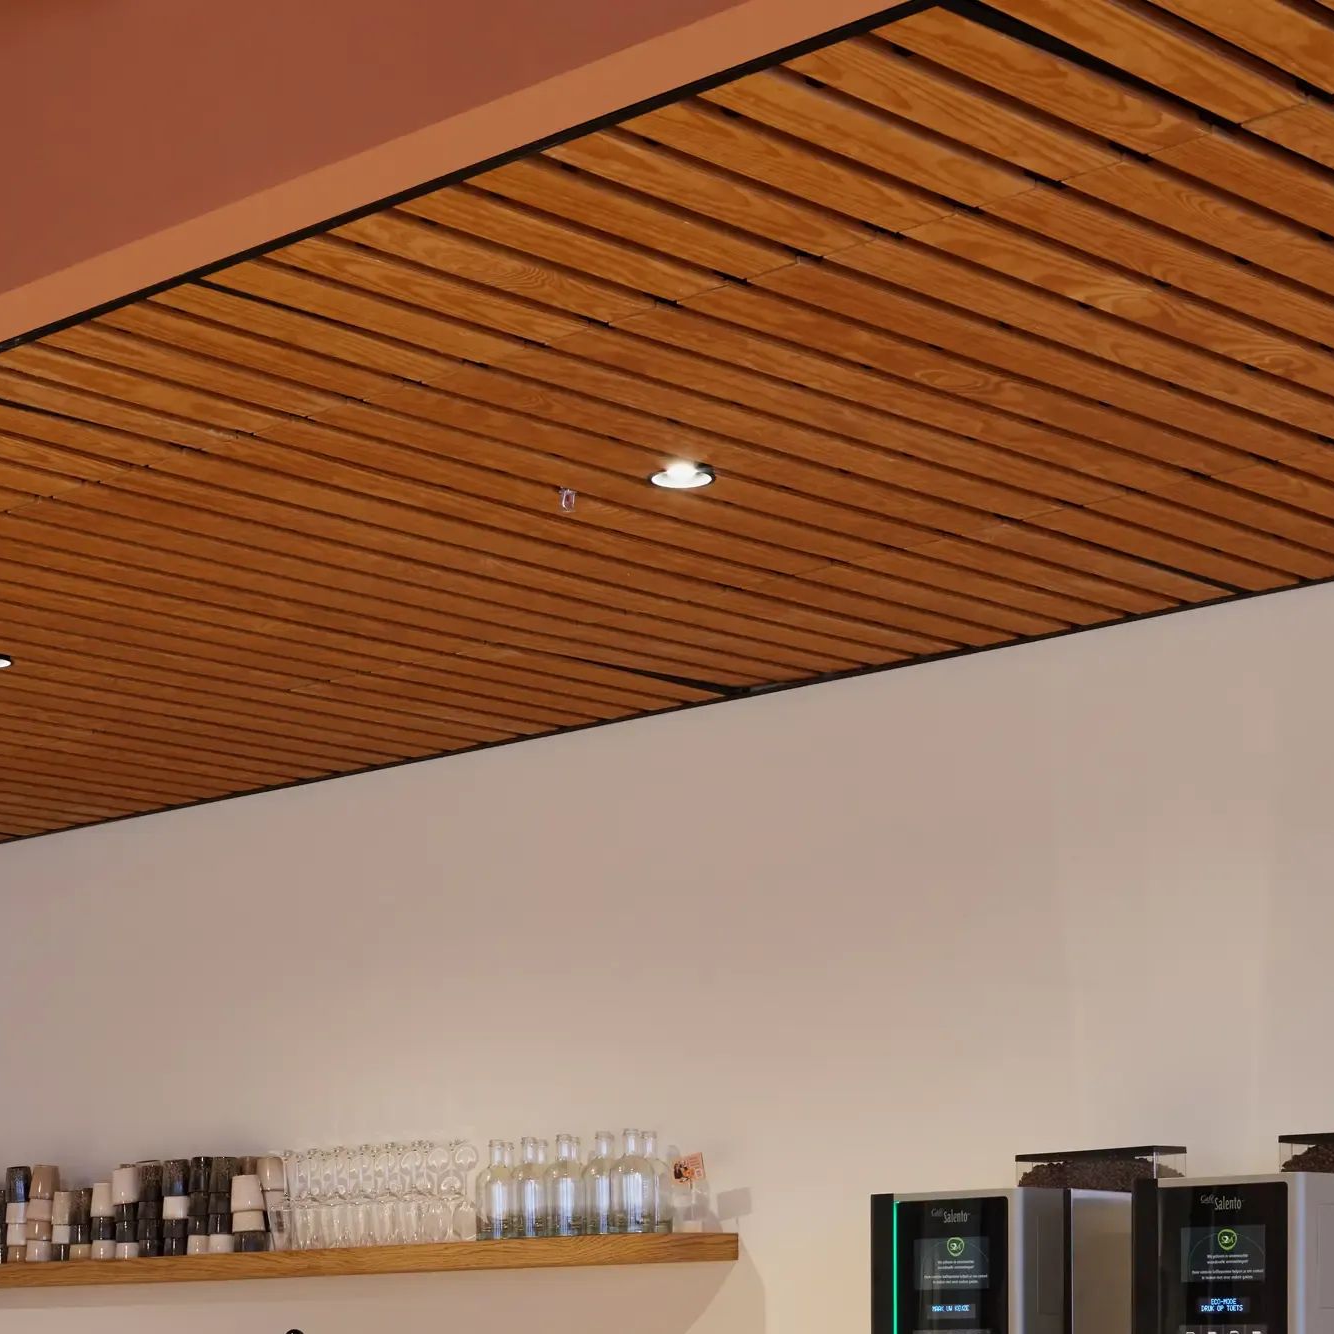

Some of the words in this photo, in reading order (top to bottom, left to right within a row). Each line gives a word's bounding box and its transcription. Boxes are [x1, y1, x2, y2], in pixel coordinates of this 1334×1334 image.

[1214, 1195, 1242, 1210] Salento
[943, 1209, 968, 1223] Salento
[1201, 1304, 1215, 1312] DRUK
[1216, 1304, 1224, 1312] OP
[1227, 1304, 1244, 1312] TOETS
